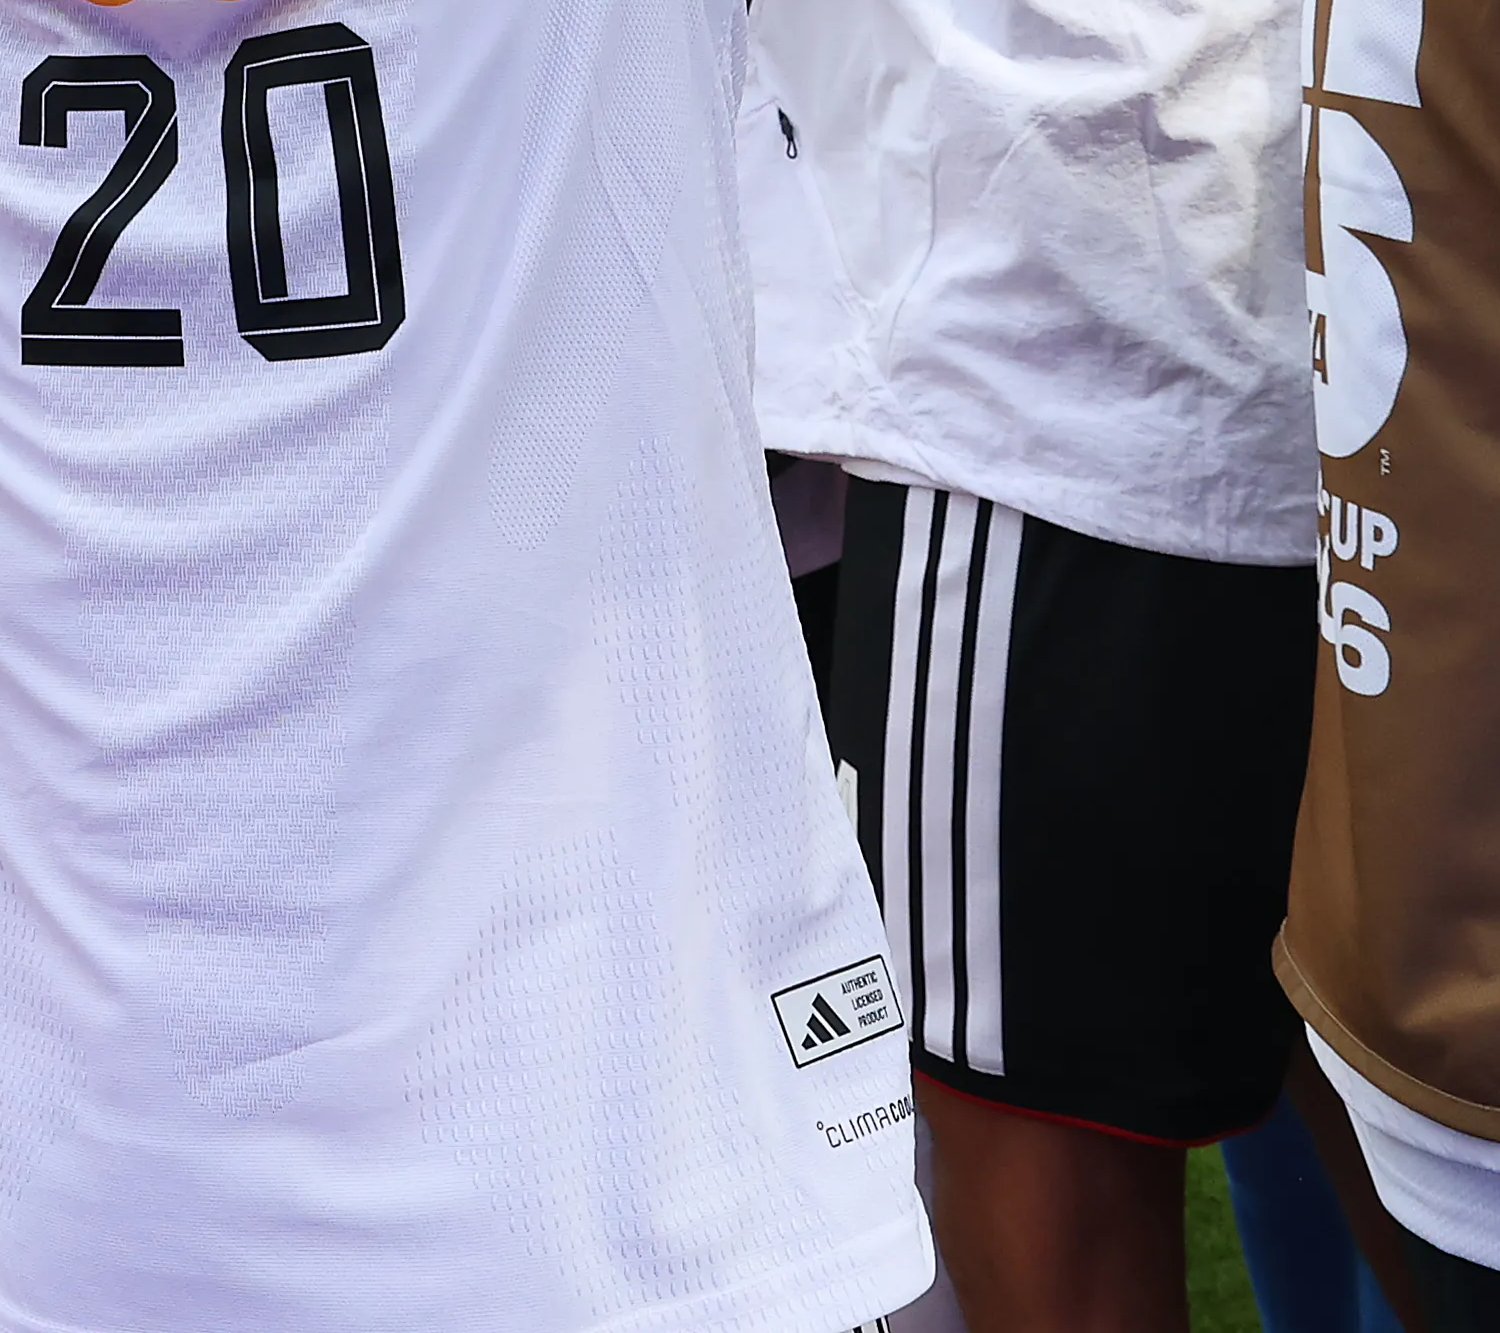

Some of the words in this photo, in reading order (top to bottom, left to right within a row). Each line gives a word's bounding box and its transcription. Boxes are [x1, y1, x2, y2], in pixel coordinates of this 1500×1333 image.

[18, 21, 406, 367] 20
[840, 970, 878, 995] AUTHENTIC
[852, 990, 884, 1012] LICENSED
[858, 1006, 889, 1029] PRODUCT
